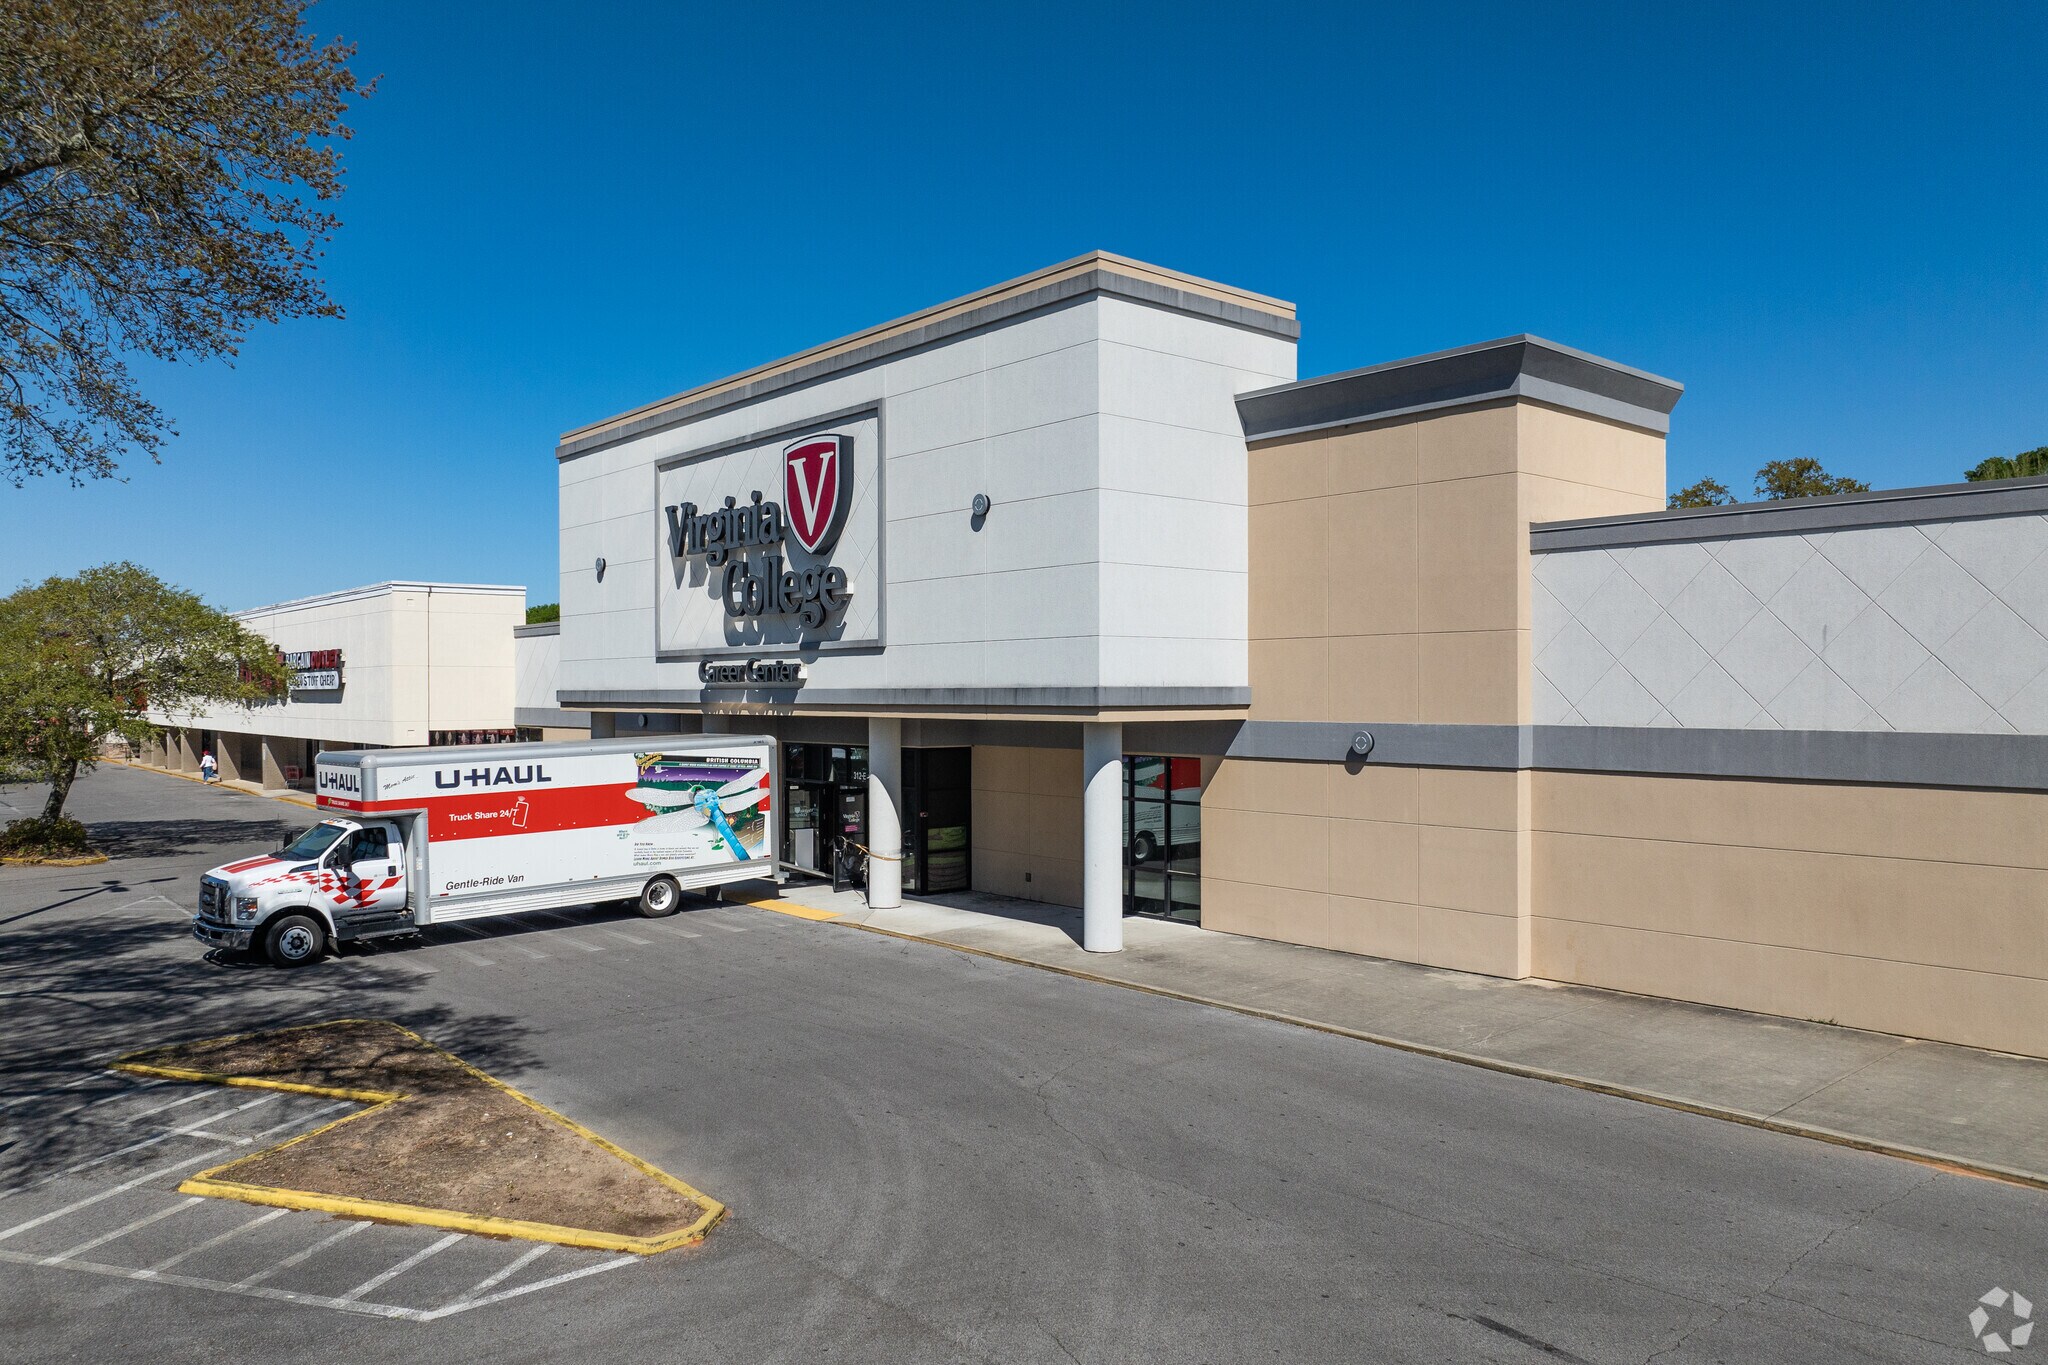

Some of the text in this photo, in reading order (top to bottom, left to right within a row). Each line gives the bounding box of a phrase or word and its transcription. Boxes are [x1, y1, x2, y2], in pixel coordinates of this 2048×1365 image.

[788, 450, 834, 537] V
[665, 490, 784, 566] Virginia
[722, 555, 848, 629] College
[311, 650, 338, 669] OUTLET
[699, 657, 802, 683] Career Center
[319, 771, 360, 793] U-HAUL
[382, 780, 401, 790] Mom's
[435, 763, 552, 789] U-HAUL
[449, 808, 519, 822] Truck Share 24/7
[445, 874, 525, 891] Gentle-Ride Van
